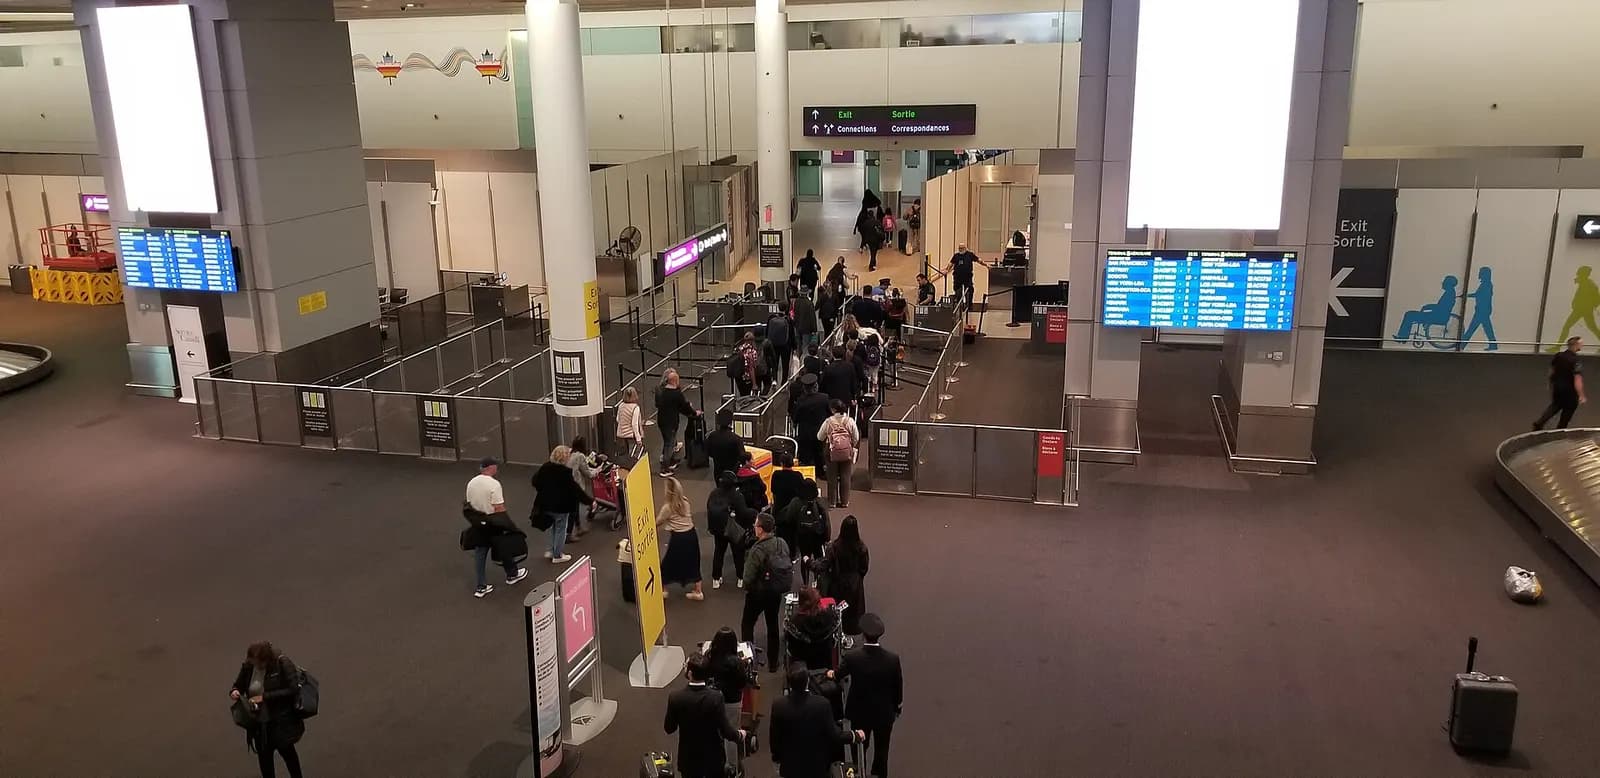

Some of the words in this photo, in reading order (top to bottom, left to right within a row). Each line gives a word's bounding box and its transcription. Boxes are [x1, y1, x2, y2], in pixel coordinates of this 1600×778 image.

[838, 110, 852, 119] Exit
[892, 110, 916, 118] Sortie
[837, 125, 877, 133] Connections
[891, 124, 950, 134] Correspondances
[1341, 220, 1368, 232] Exit
[1333, 236, 1374, 248] Sortie
[636, 506, 650, 535] Exit
[636, 528, 654, 561] Sortie
